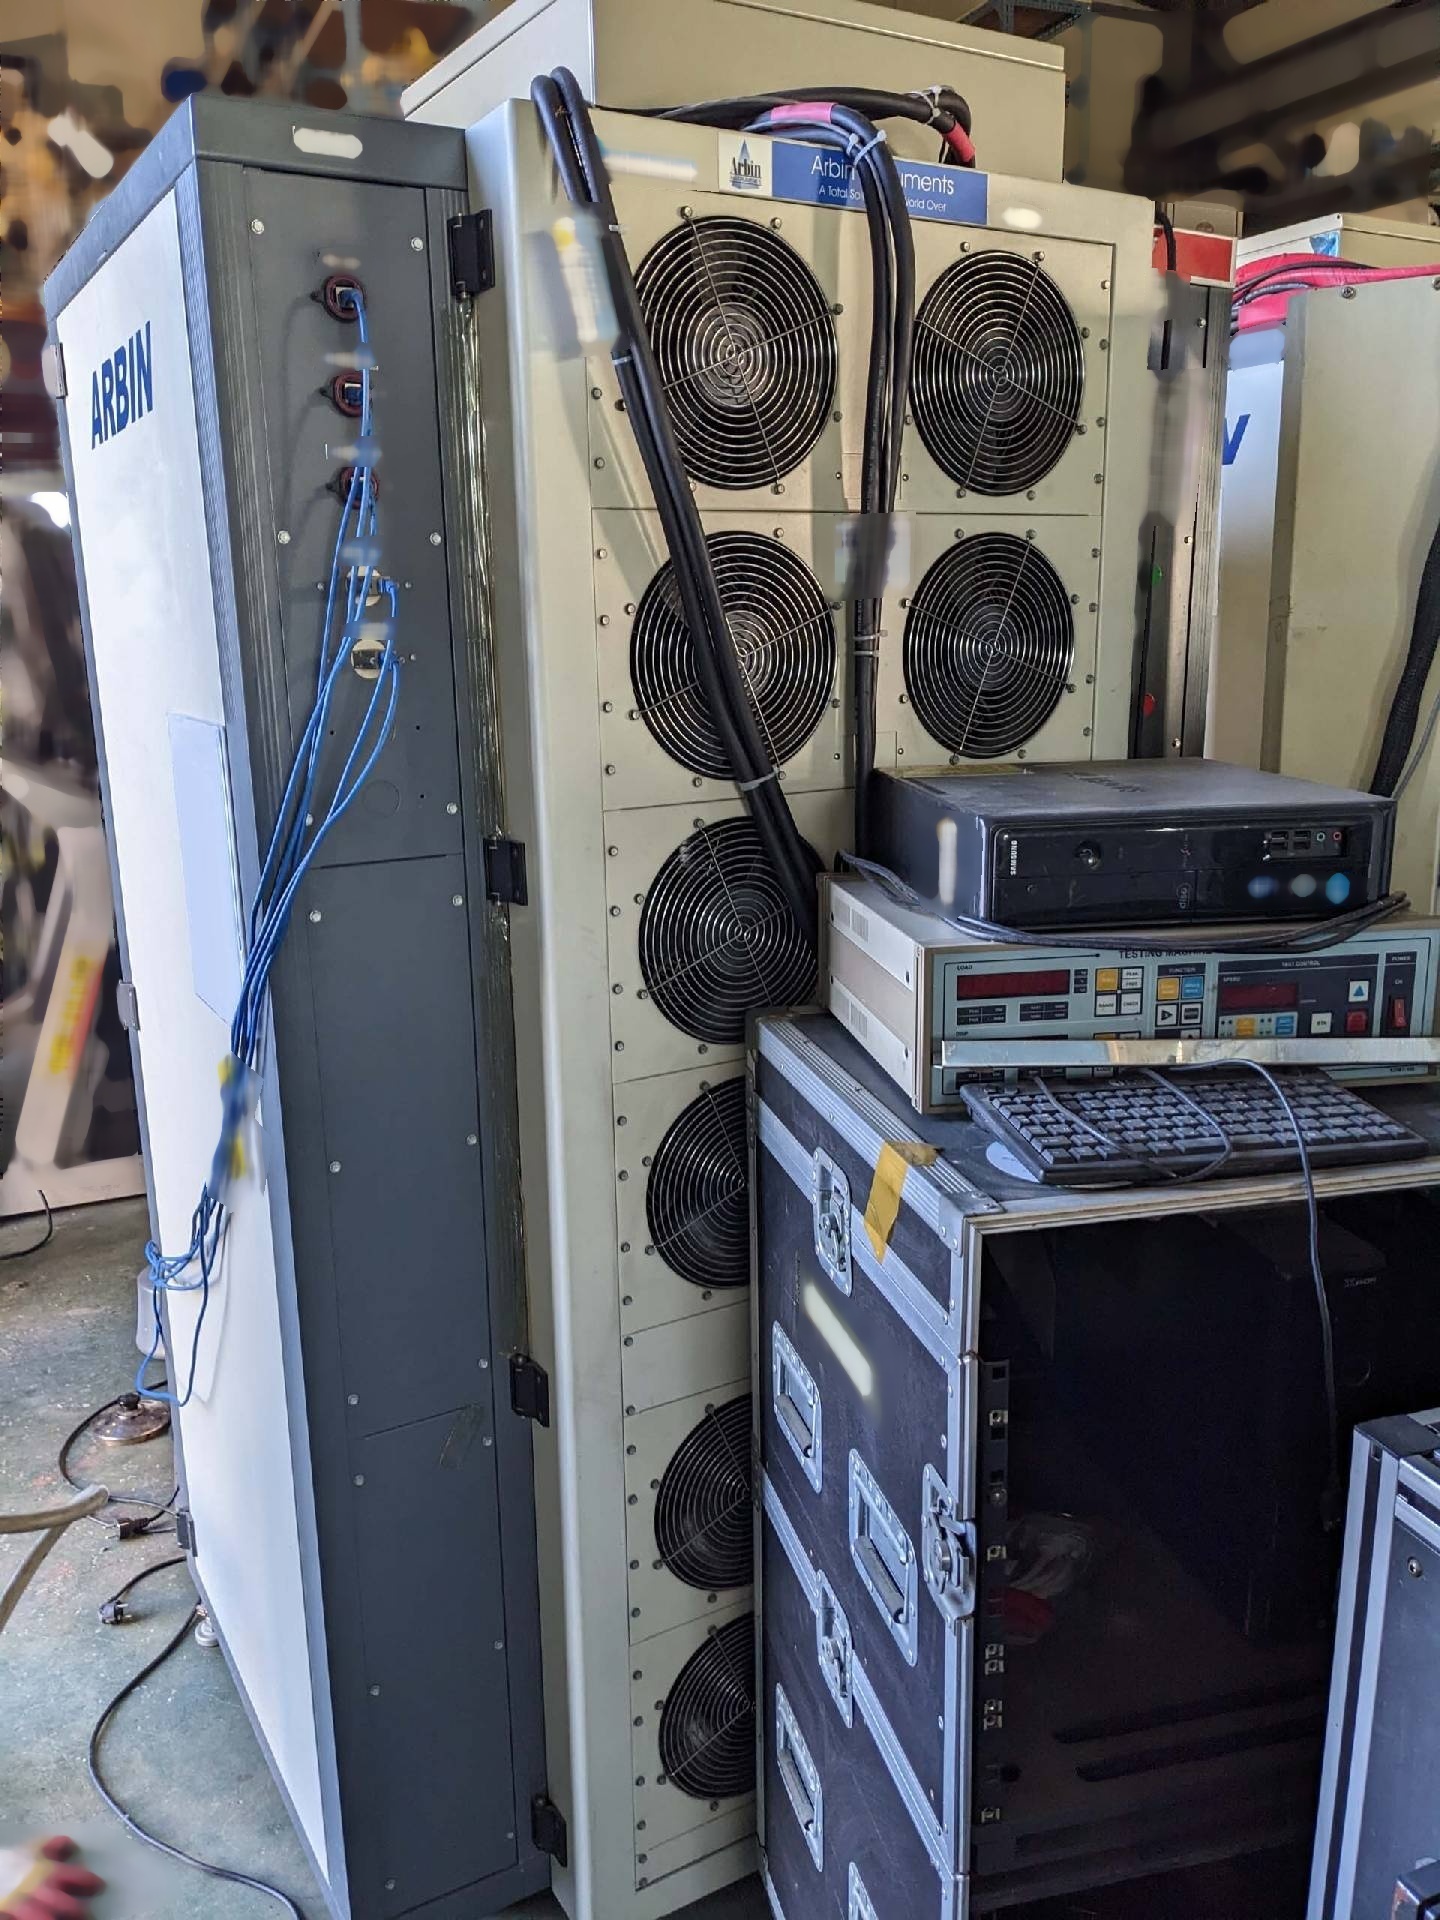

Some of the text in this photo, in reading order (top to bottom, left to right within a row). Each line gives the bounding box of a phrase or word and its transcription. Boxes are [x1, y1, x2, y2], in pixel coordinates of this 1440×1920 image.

[730, 156, 761, 179] Arbin
[811, 155, 855, 181] Arbin
[819, 185, 826, 194] A
[828, 186, 848, 198] Total
[926, 200, 947, 212] Over
[92, 320, 153, 450] ARBIN
[1010, 840, 1018, 876] SAMSUNG
